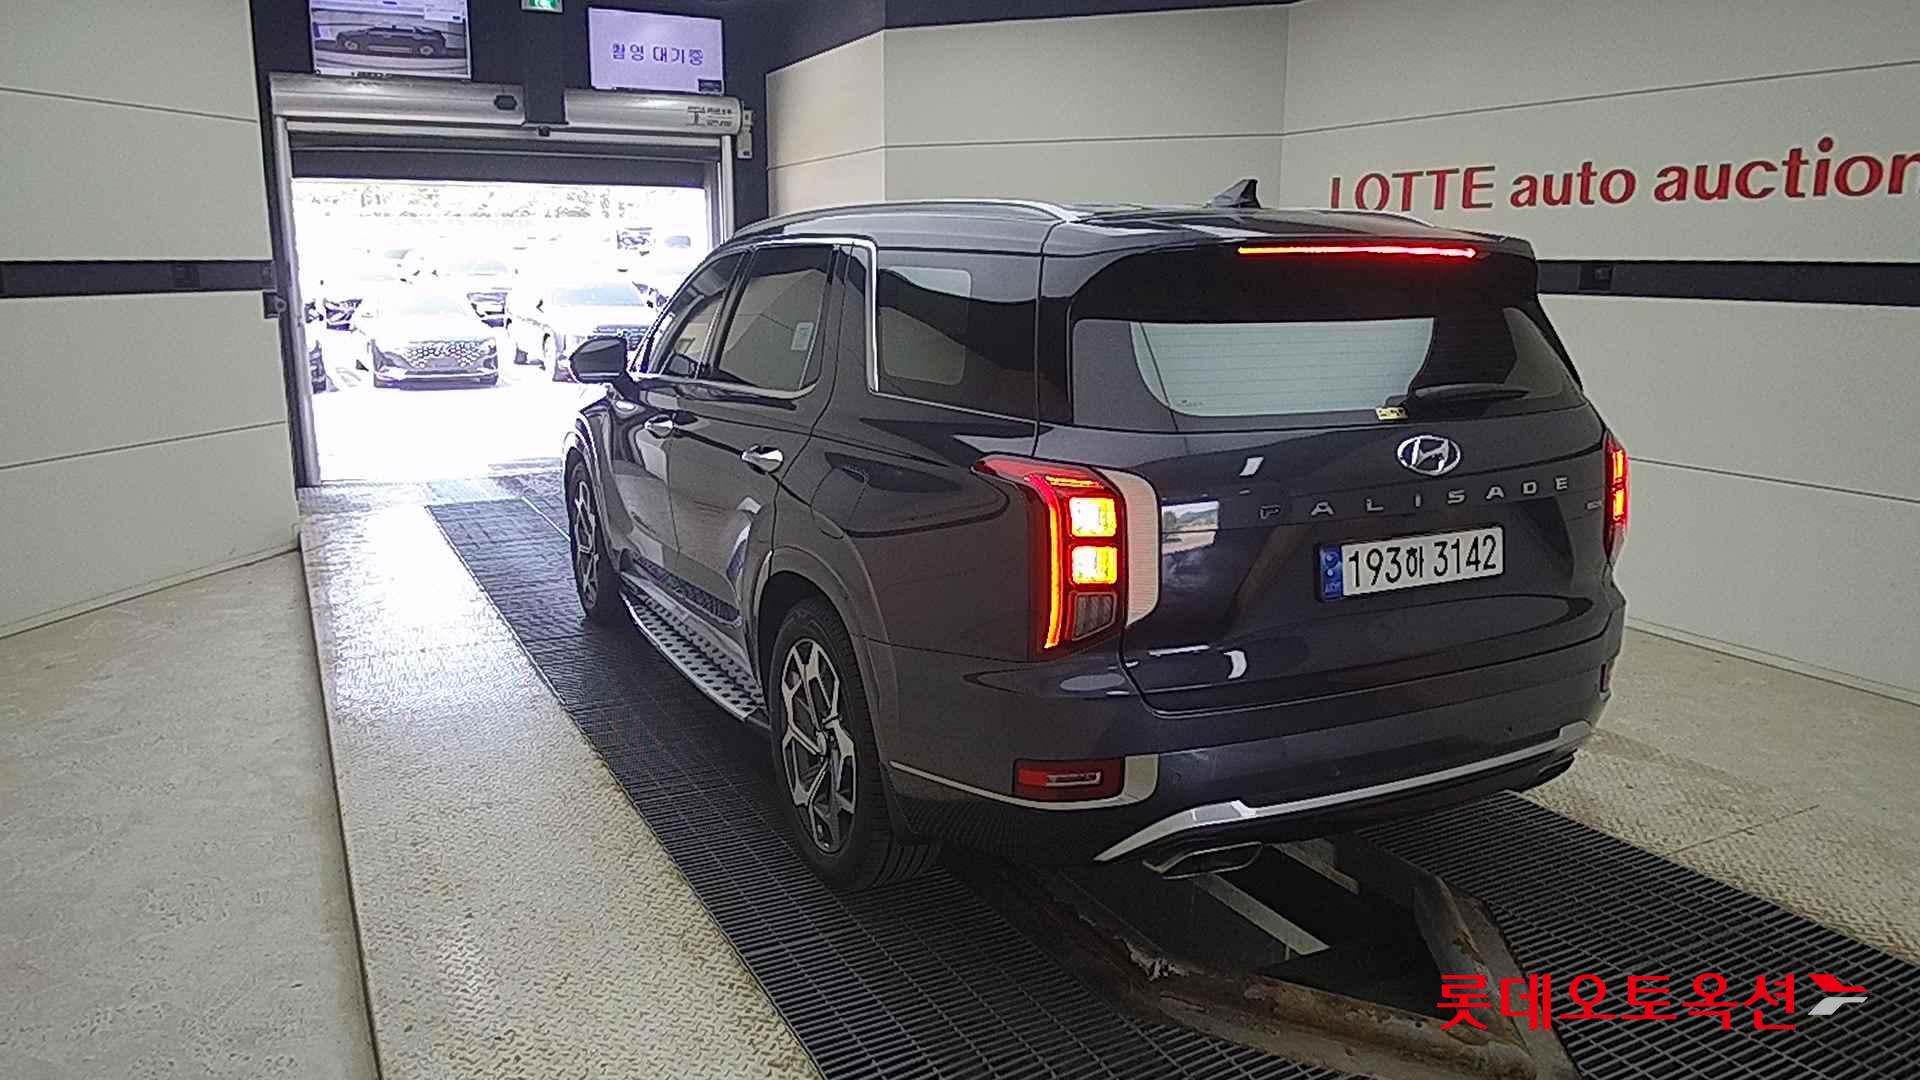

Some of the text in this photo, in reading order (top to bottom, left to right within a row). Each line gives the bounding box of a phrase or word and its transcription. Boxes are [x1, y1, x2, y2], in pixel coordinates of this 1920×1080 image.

[652, 46, 704, 66] 대기중
[1510, 161, 1636, 208] auto
[1654, 136, 1920, 202] auction
[1259, 475, 1569, 520] PALISADE
[1349, 534, 1497, 588] 193하 3142
